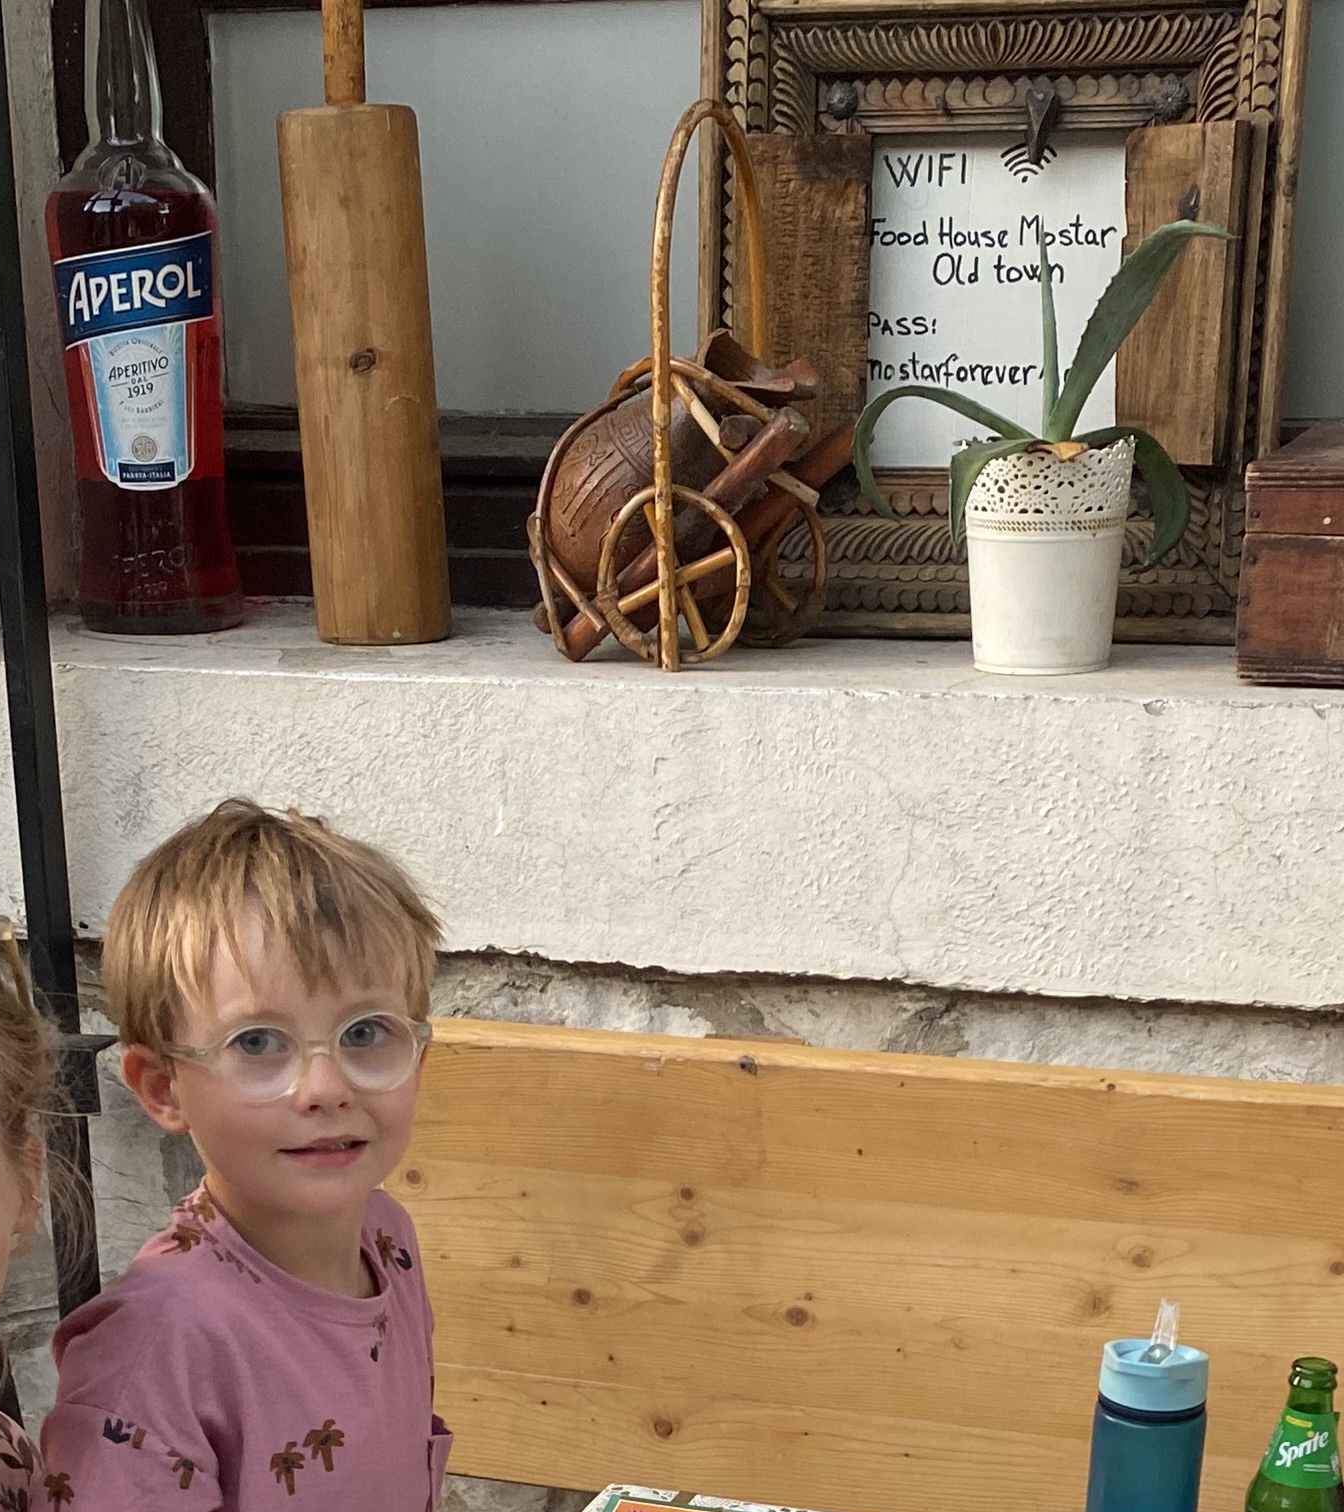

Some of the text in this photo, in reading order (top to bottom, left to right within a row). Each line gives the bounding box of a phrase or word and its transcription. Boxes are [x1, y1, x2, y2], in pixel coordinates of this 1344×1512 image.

[883, 152, 968, 188] WIFI
[869, 213, 1118, 249] Food House Mostar
[932, 252, 1065, 286] Old town
[69, 260, 202, 326] APEROL
[108, 356, 169, 381] APERITIVO
[130, 376, 148, 385] DAL
[127, 382, 154, 398] 1919
[1275, 1430, 1329, 1468] Sprite
